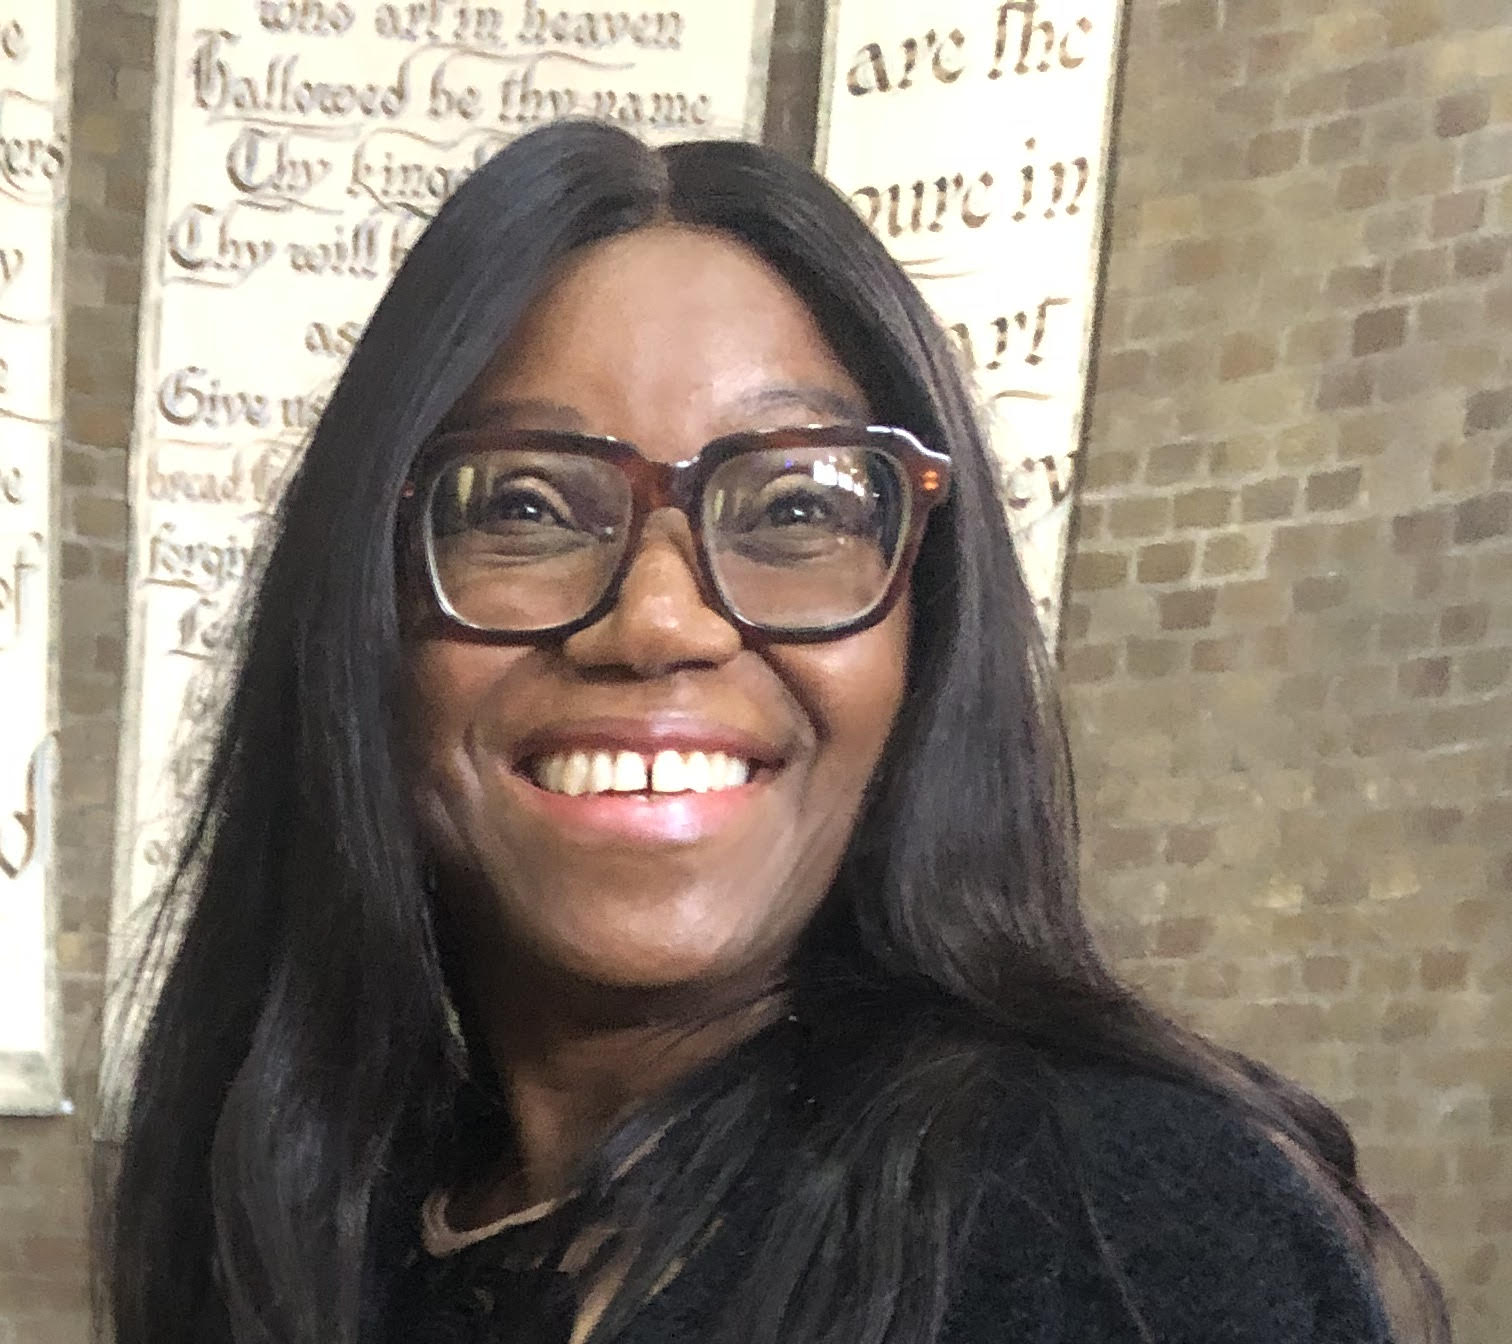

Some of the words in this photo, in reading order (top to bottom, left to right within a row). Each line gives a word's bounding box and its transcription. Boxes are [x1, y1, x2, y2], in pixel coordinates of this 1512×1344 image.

[846, 28, 966, 97] are
[984, 0, 1093, 80] the
[429, 55, 480, 120] be
[346, 140, 486, 208] king
[1011, 136, 1090, 219] in
